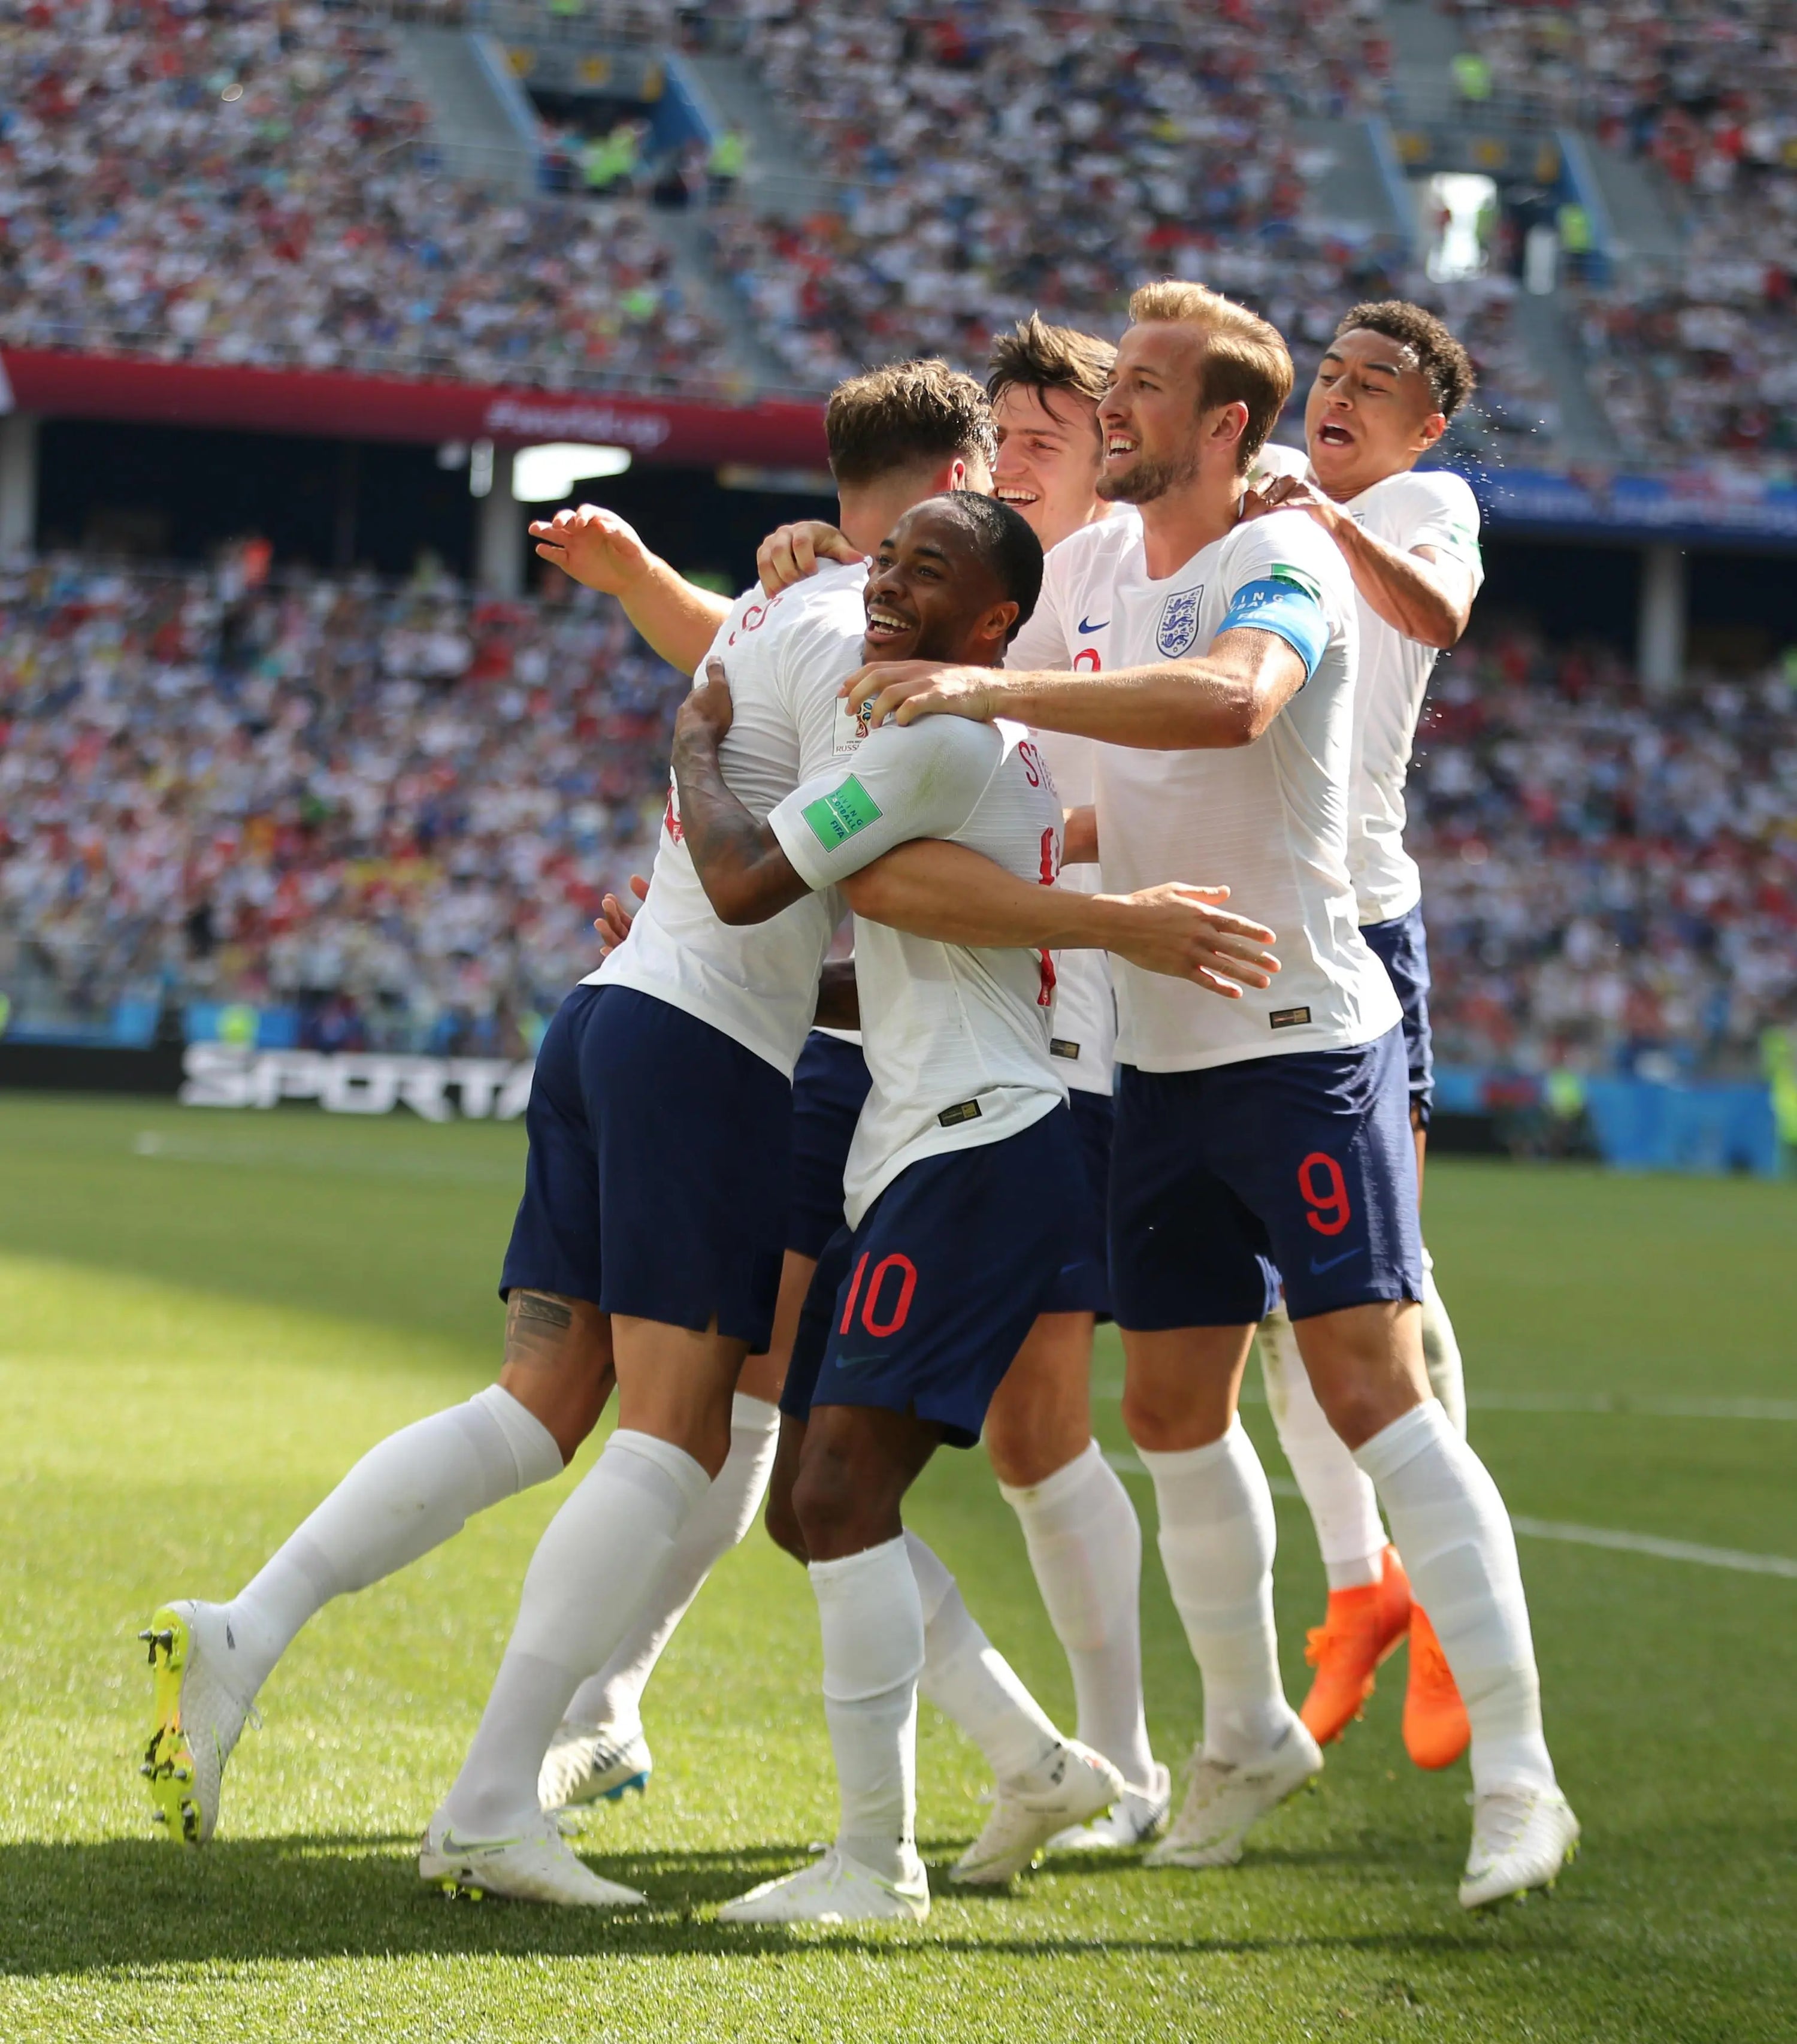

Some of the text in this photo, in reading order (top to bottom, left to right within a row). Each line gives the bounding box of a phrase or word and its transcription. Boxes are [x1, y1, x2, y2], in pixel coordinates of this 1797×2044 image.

[830, 820, 845, 839] FIFA
[1297, 1151, 1351, 1236] 9
[840, 1251, 918, 1338] 10
